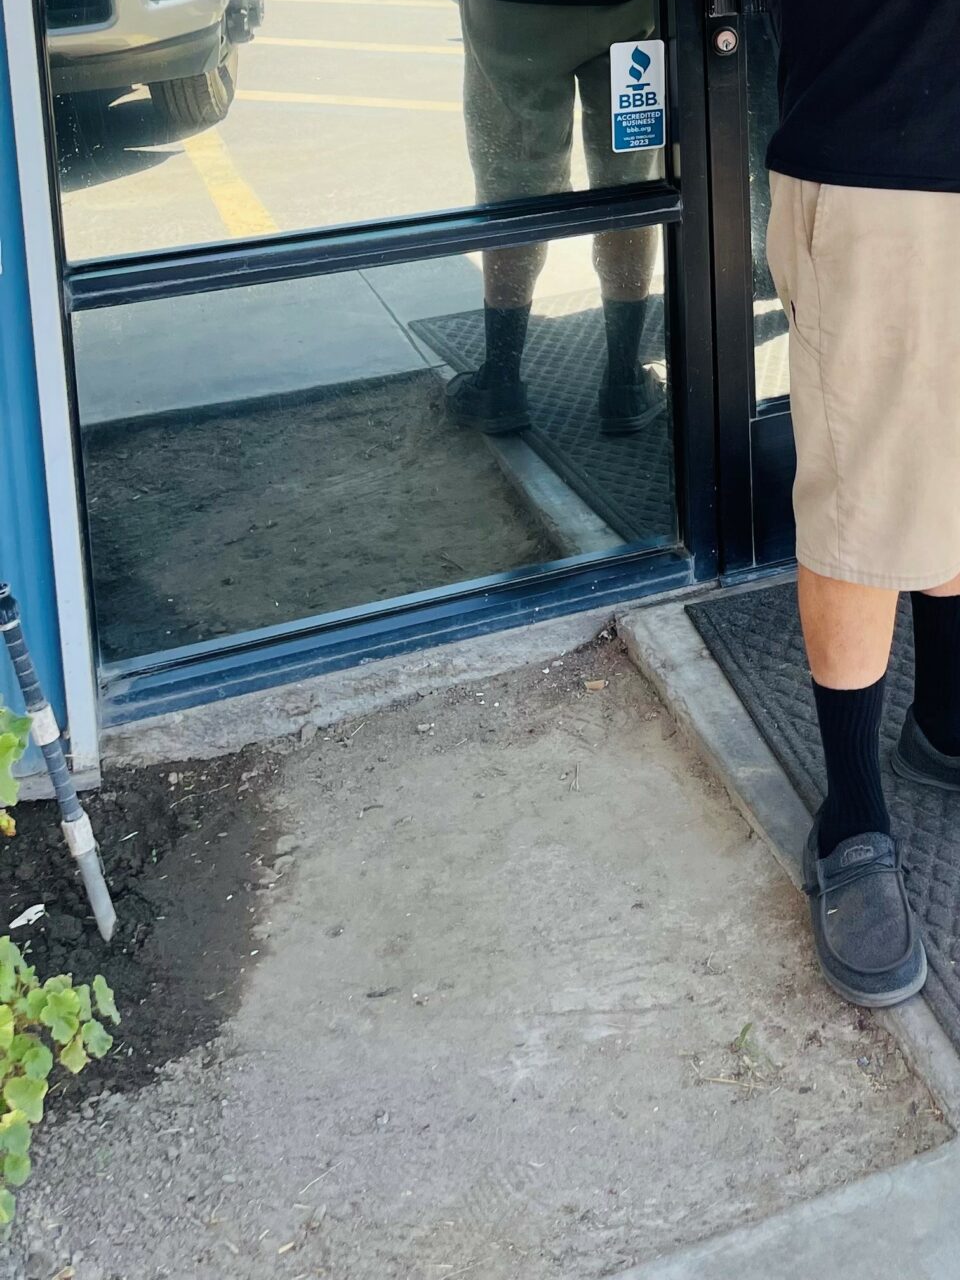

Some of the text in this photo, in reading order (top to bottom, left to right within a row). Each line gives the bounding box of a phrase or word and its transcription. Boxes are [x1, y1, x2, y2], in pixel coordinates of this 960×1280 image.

[619, 92, 658, 109] BBB
[616, 111, 661, 122] ACCREDITED
[622, 118, 655, 127] BUSINESS
[629, 139, 649, 147] 2023
